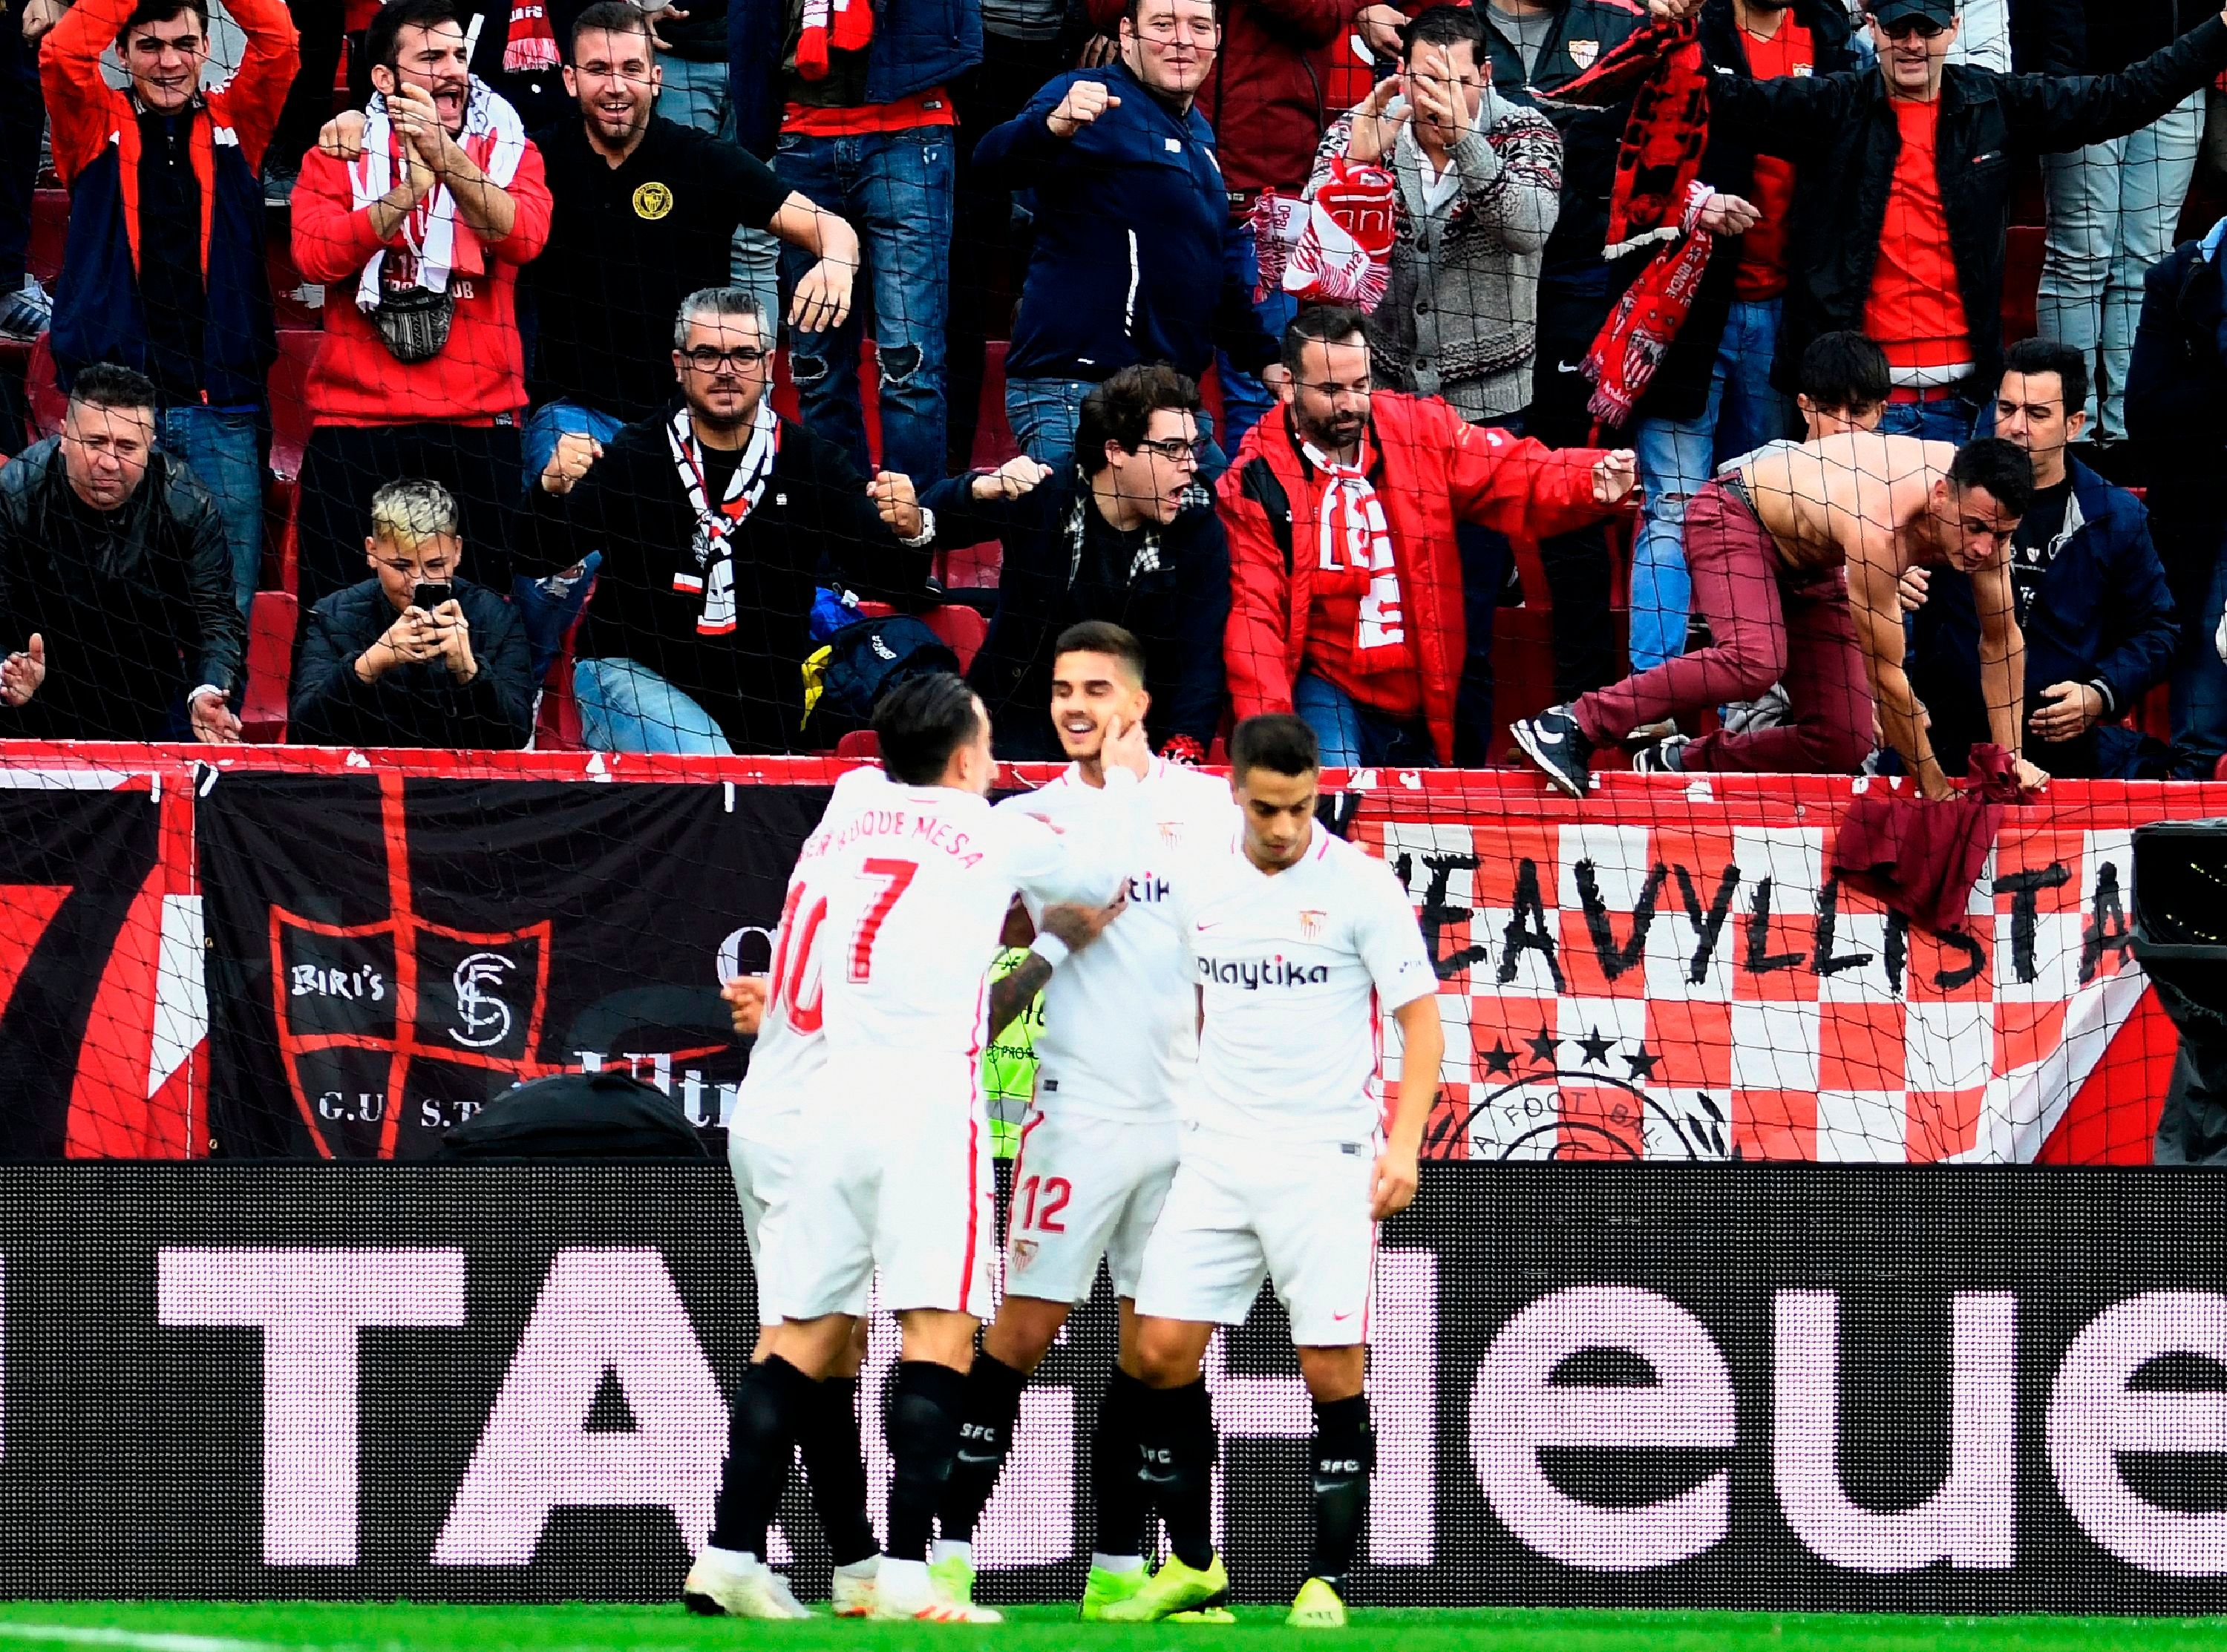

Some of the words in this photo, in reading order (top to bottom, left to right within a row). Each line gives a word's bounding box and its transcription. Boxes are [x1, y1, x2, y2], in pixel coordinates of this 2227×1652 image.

[912, 816, 984, 870] MESA
[847, 857, 920, 983] 7
[1021, 1174, 1072, 1235] 12
[959, 1423, 995, 1442] SFC
[1320, 1459, 1360, 1473] SFC
